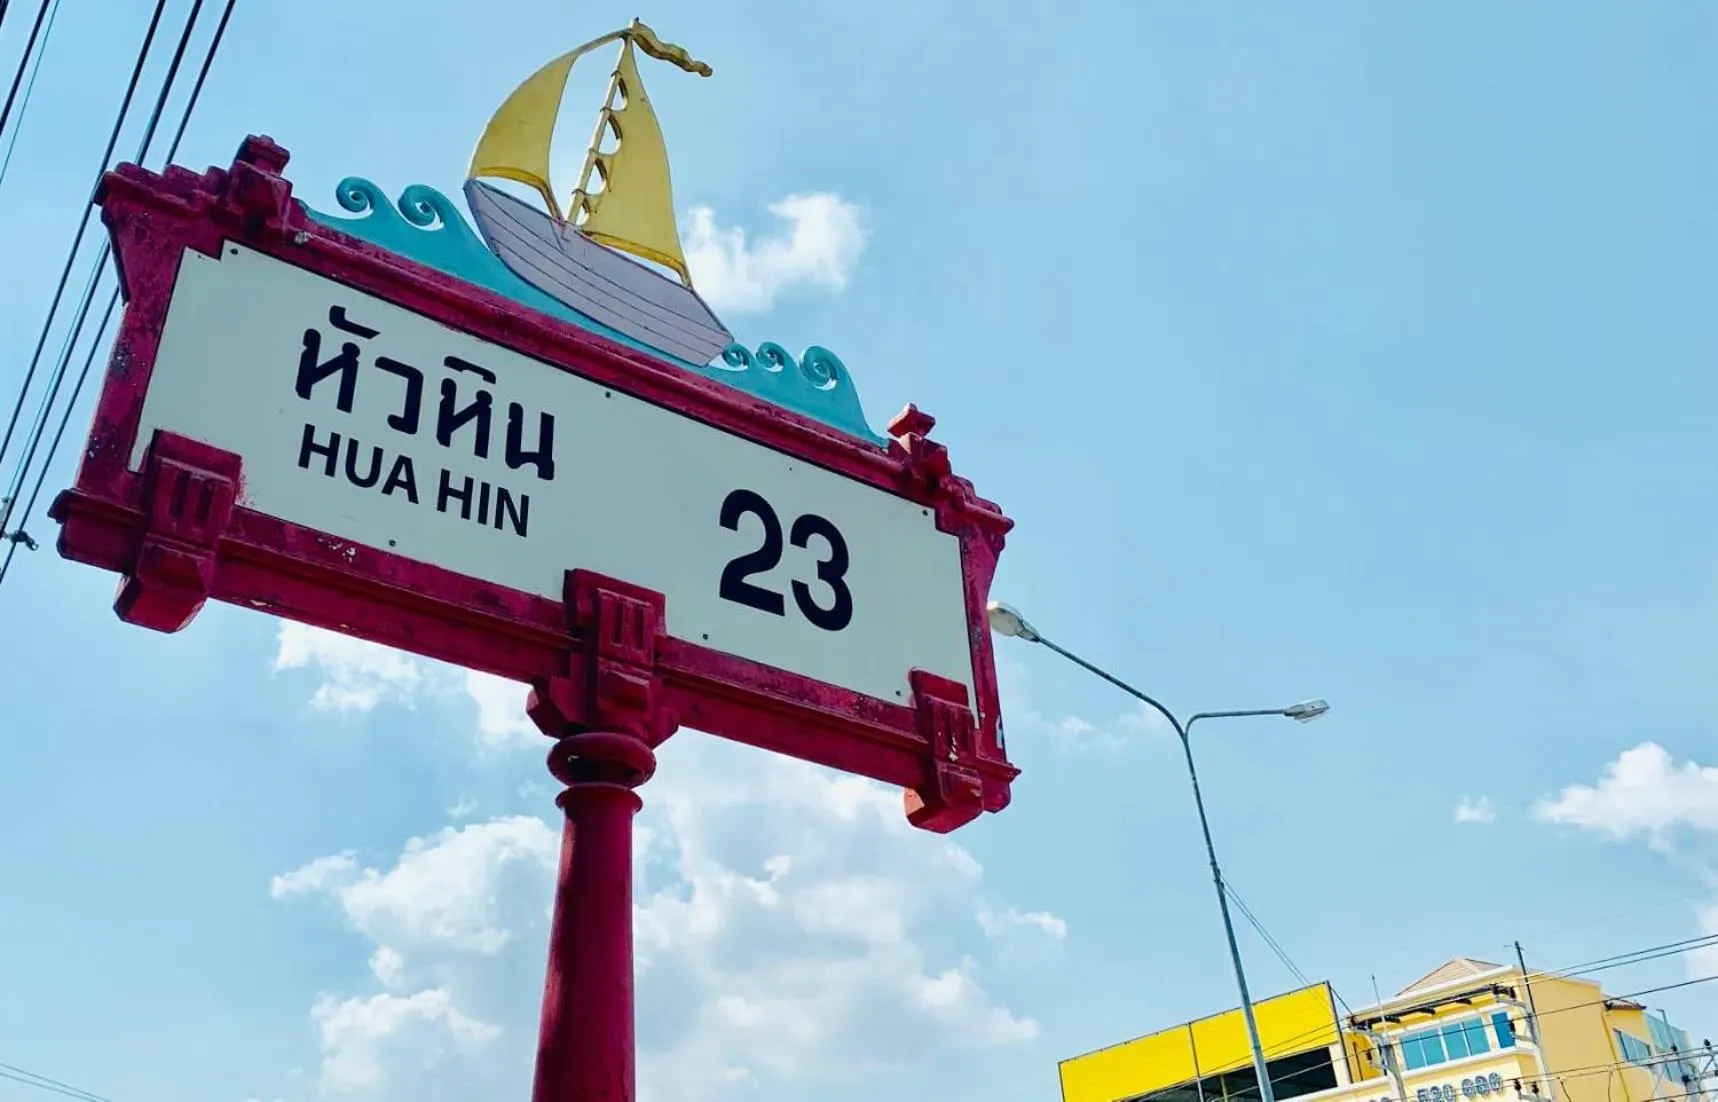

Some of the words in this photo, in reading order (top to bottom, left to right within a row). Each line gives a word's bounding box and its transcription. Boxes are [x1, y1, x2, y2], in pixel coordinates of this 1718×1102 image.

[296, 306, 555, 481] หัวหิน
[298, 424, 419, 504] HUA
[437, 469, 530, 537] HIN
[720, 489, 853, 631] 23
